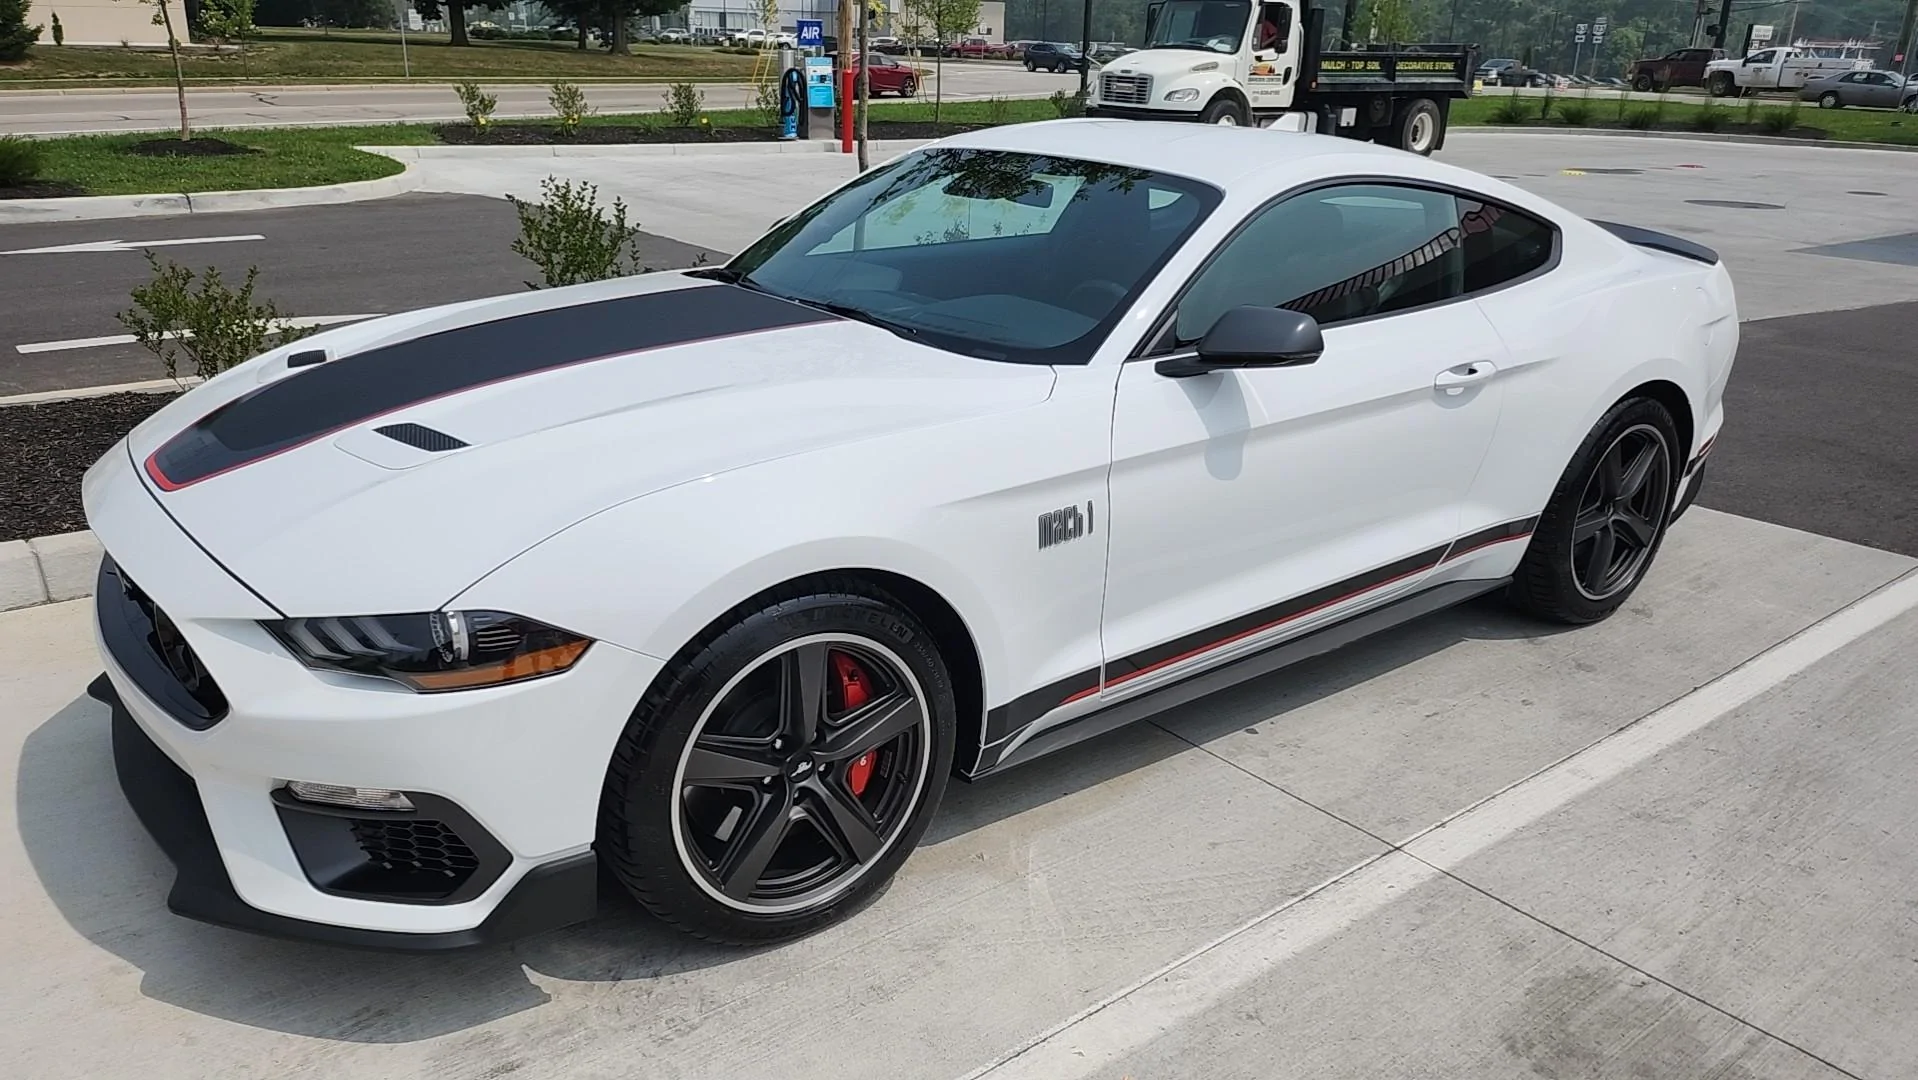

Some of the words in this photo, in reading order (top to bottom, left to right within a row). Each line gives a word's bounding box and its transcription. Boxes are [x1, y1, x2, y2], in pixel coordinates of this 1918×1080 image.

[800, 26, 820, 39] AIR
[1320, 60, 1346, 70] MULCH
[1351, 60, 1365, 70] TOP
[1366, 60, 1381, 70] SOIL
[1395, 61, 1434, 70] DECORATIVE
[1435, 61, 1455, 70] STONE
